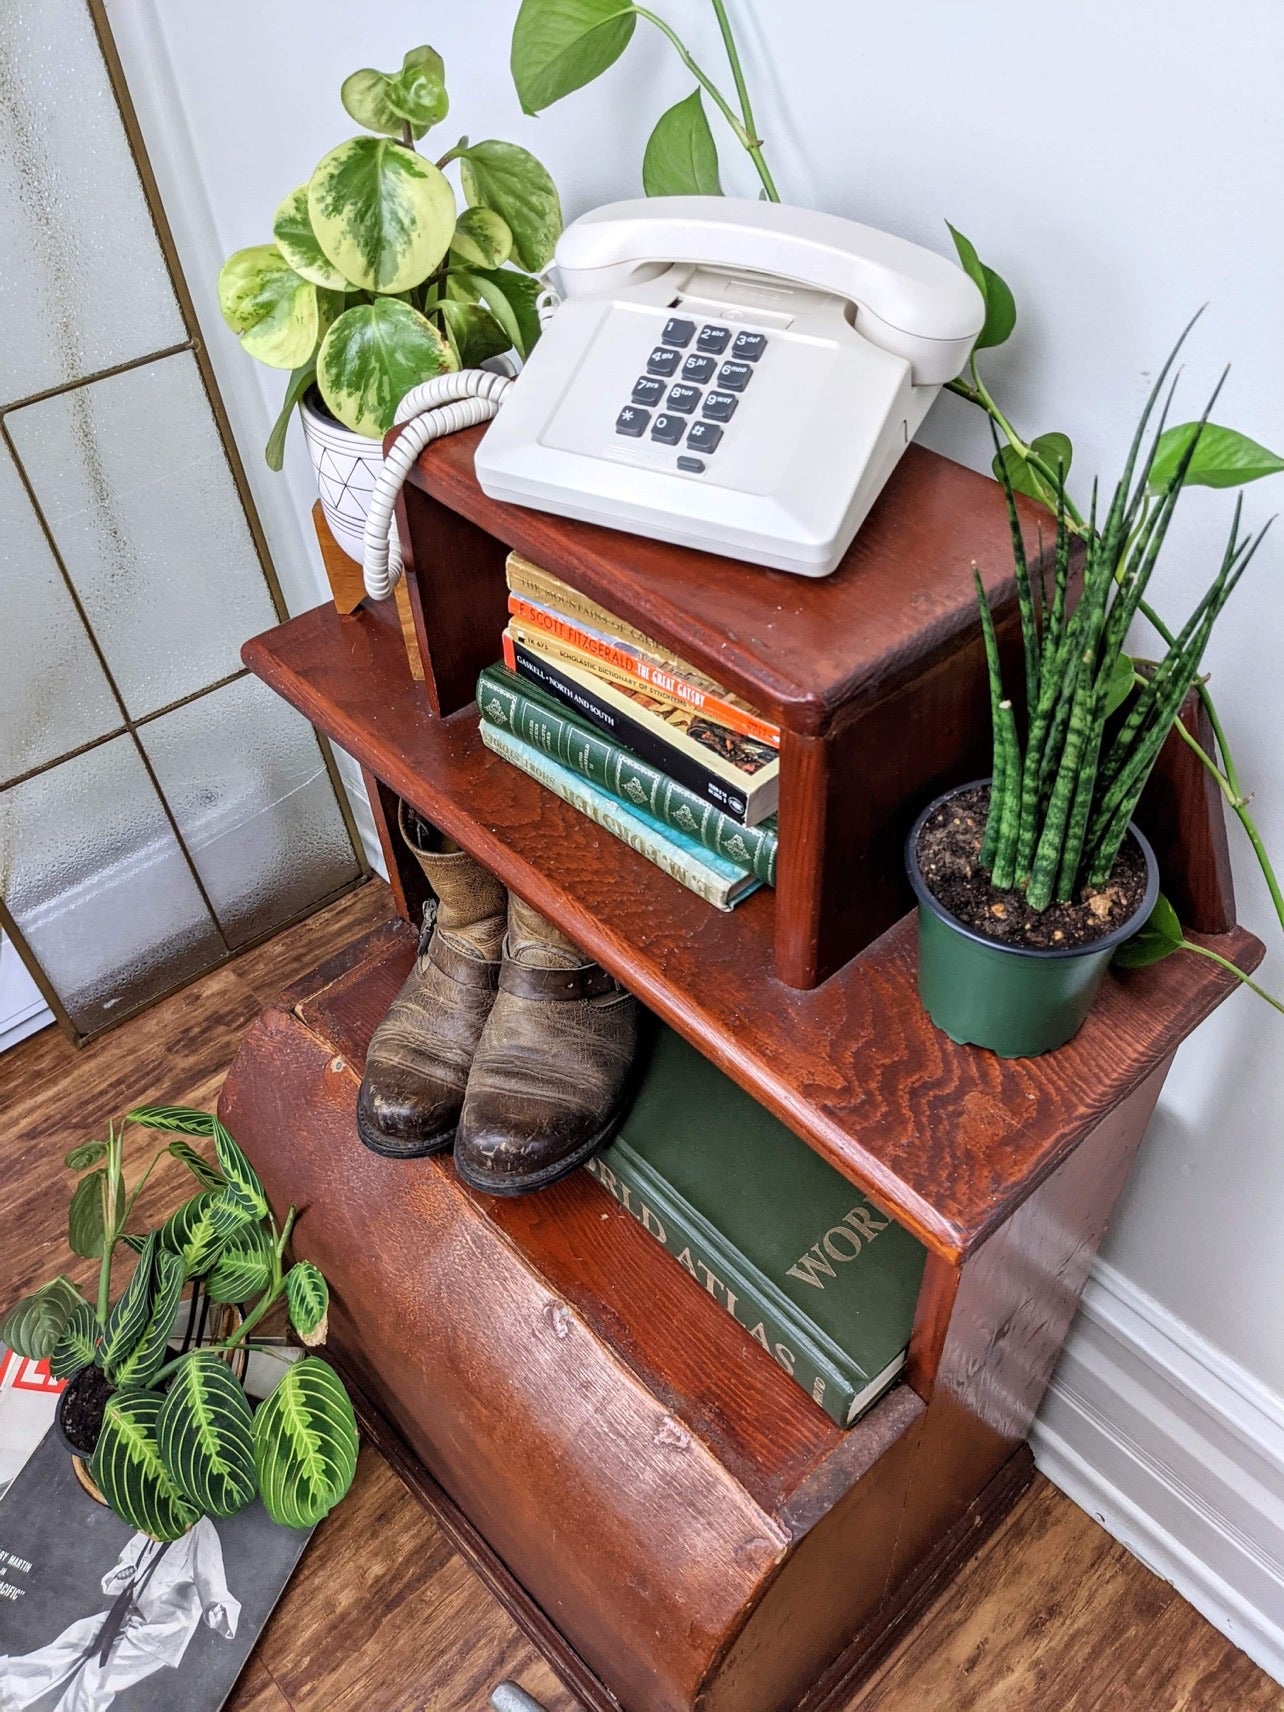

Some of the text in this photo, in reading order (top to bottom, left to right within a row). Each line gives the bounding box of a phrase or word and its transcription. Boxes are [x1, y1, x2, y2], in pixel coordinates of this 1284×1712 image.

[666, 321, 674, 331] 1
[516, 655, 615, 727] GASKELL NORTH AND SOUTH
[529, 608, 566, 636] SCOTT
[568, 626, 634, 671] FITZGERALD
[636, 662, 651, 681] THE
[651, 670, 676, 693] GREAT
[676, 683, 706, 708] GATSBY
[559, 650, 597, 670] SCHOLASTIC
[597, 663, 638, 687] DICTIONARY
[583, 1157, 797, 1378] RLD ATLAS
[784, 1198, 895, 1290] WOR
[7, 1554, 33, 1573] MARTIN
